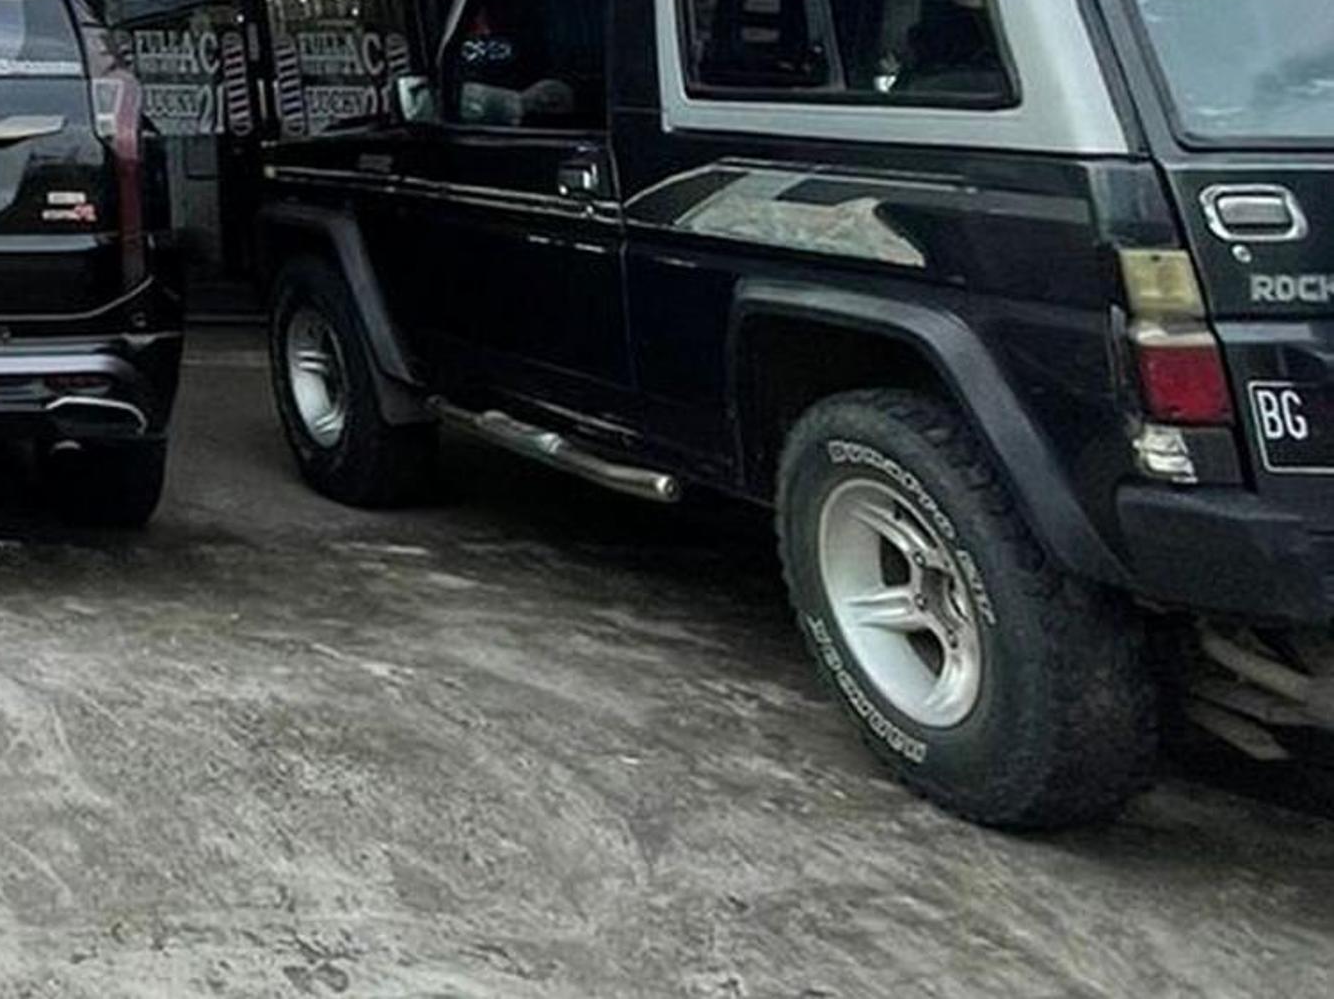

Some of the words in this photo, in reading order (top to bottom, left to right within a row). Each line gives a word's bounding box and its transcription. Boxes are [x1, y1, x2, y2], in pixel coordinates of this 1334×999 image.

[178, 30, 221, 75] AC
[342, 32, 386, 75] AC
[1257, 388, 1309, 441] BG
